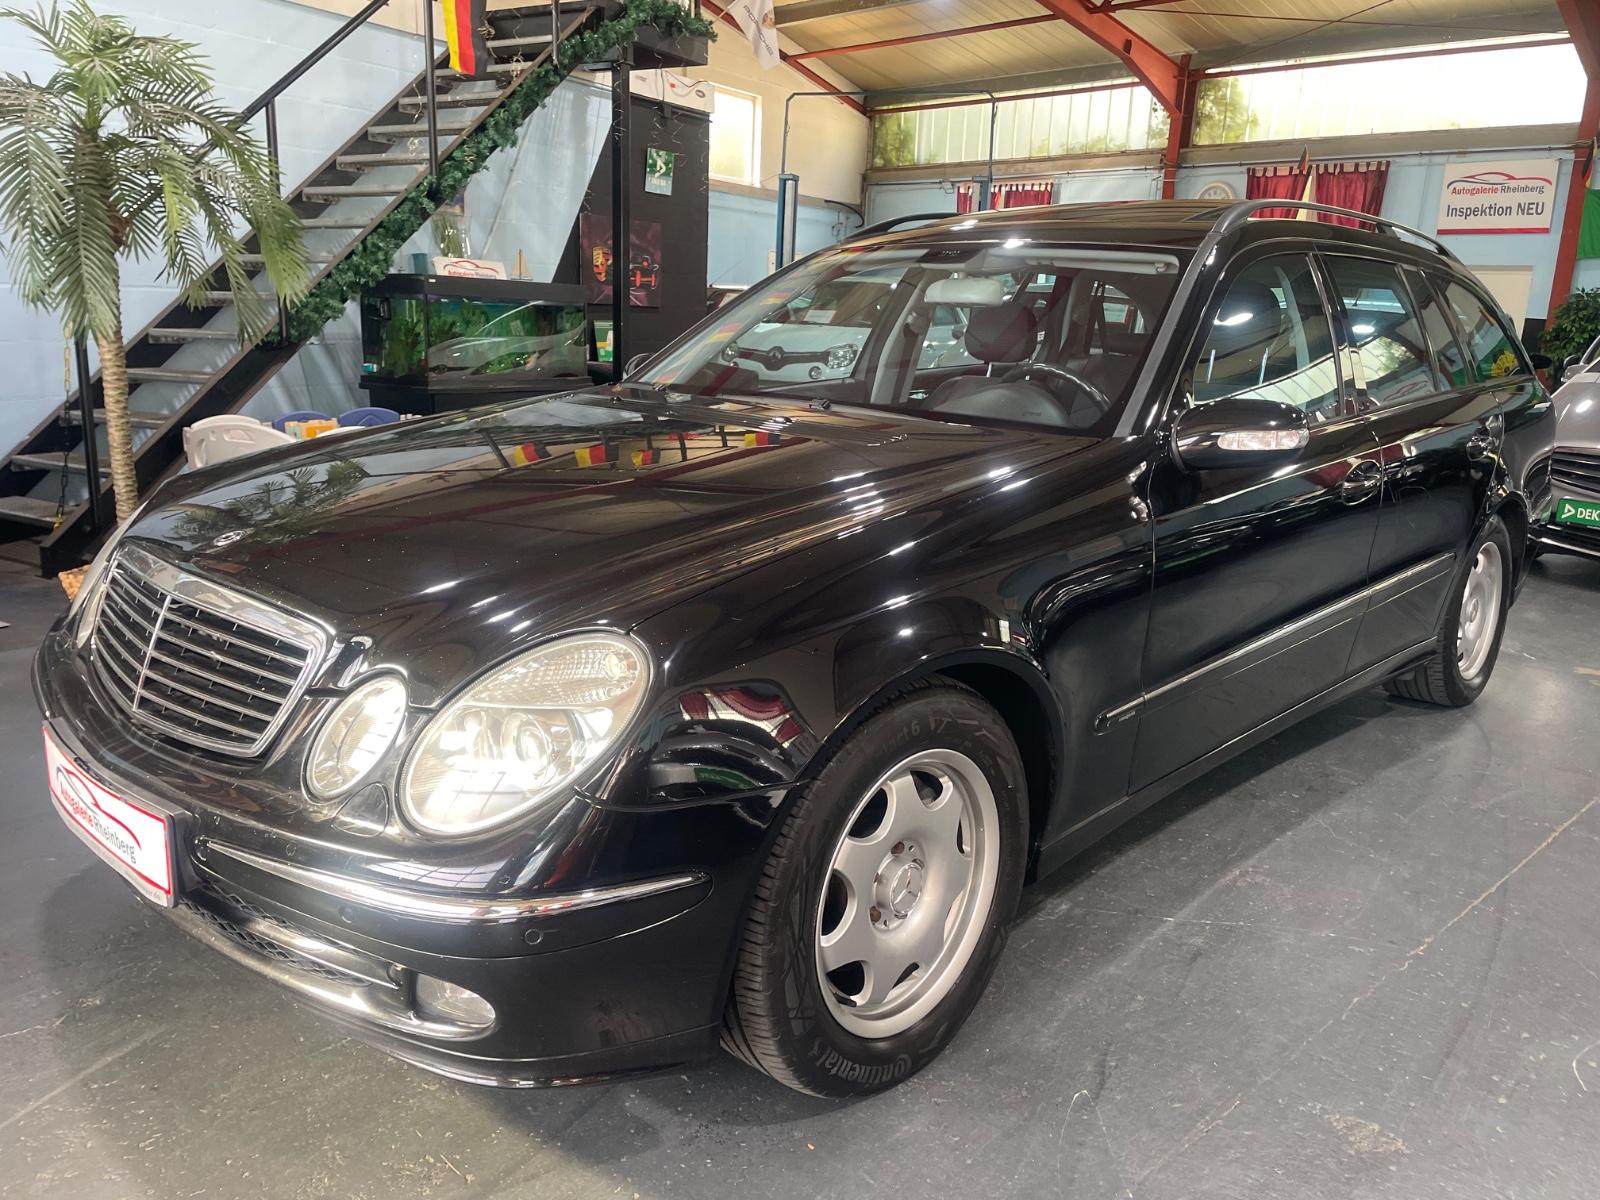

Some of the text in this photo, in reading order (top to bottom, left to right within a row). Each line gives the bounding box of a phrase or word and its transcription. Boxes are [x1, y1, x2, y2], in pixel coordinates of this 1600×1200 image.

[1451, 184, 1545, 195] Autogalerie Rheinberg
[1446, 202, 1544, 219] Inspektion NEU
[92, 814, 137, 864] Rheinberg
[815, 1046, 913, 1086] Continental
